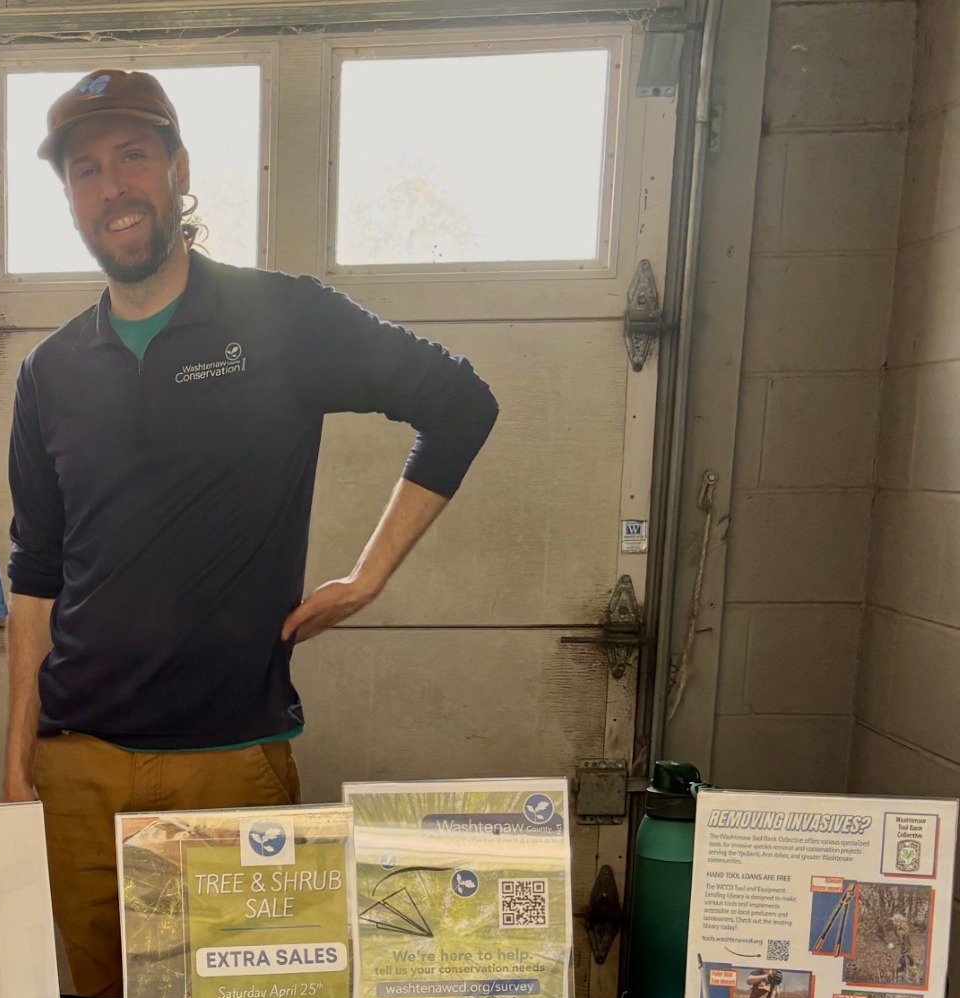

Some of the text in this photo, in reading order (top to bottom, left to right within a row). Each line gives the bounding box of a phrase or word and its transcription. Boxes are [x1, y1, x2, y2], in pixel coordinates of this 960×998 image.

[175, 364, 240, 384] Conservation
[437, 819, 552, 834] Washtenaw County
[707, 809, 872, 835] REMOVING INVASIVES?
[195, 870, 342, 895] TREE & SHRUB
[245, 897, 295, 919] SALE
[206, 948, 338, 969] EXTRA SALES
[392, 948, 534, 963] We're here to help.
[374, 962, 545, 978] tell us your conservation needs
[300, 983, 324, 996] 25th
[385, 980, 534, 994] washtenawcd.org/survey
